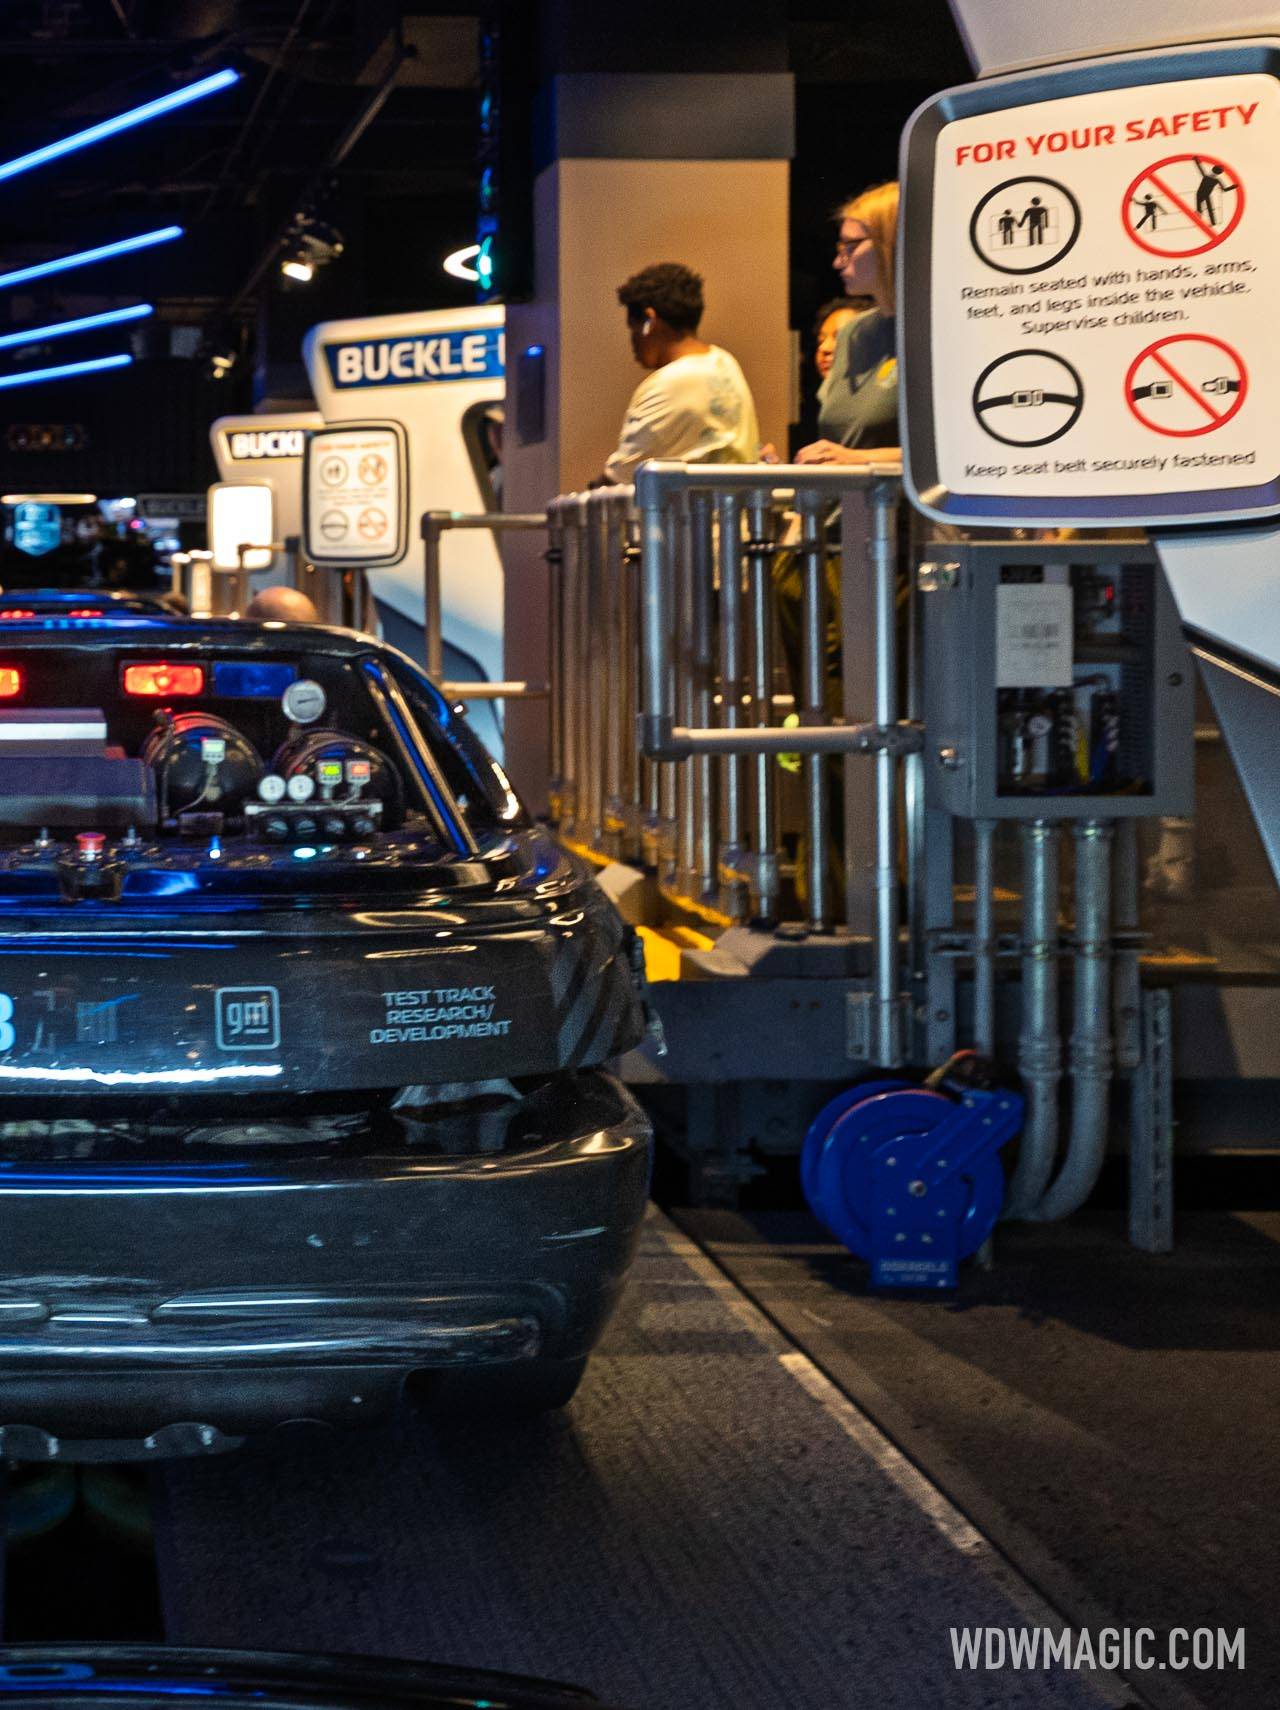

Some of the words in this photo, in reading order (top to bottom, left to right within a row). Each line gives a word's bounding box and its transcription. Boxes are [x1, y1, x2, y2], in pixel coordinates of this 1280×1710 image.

[956, 139, 1016, 166] FOR
[1025, 125, 1115, 155] YOUR
[1126, 102, 1260, 142] SAFETY
[960, 283, 1024, 301] Remain
[1029, 276, 1087, 294] seated
[1092, 270, 1131, 287] with
[1136, 263, 1198, 283] hands,
[1203, 259, 1257, 275] arms,
[966, 305, 1004, 320] feet,
[1009, 298, 1041, 315] and
[1046, 296, 1082, 315] legs
[1086, 288, 1140, 307] inside
[1145, 285, 1174, 301] the
[1020, 314, 1108, 336] Supervise
[1113, 307, 1190, 327] children.
[337, 335, 487, 383] BUCKLE
[964, 463, 1007, 479] Keep
[1013, 461, 1049, 475] seat
[1053, 458, 1087, 473] belt
[1092, 454, 1168, 472] securely
[1172, 450, 1256, 468] fastened
[381, 989, 432, 1007] TEST
[433, 985, 497, 1003] TRACK
[226, 1001, 269, 1035] gm
[385, 1003, 495, 1024] RESEARCH/
[370, 1020, 513, 1044] DEVELOPMENT
